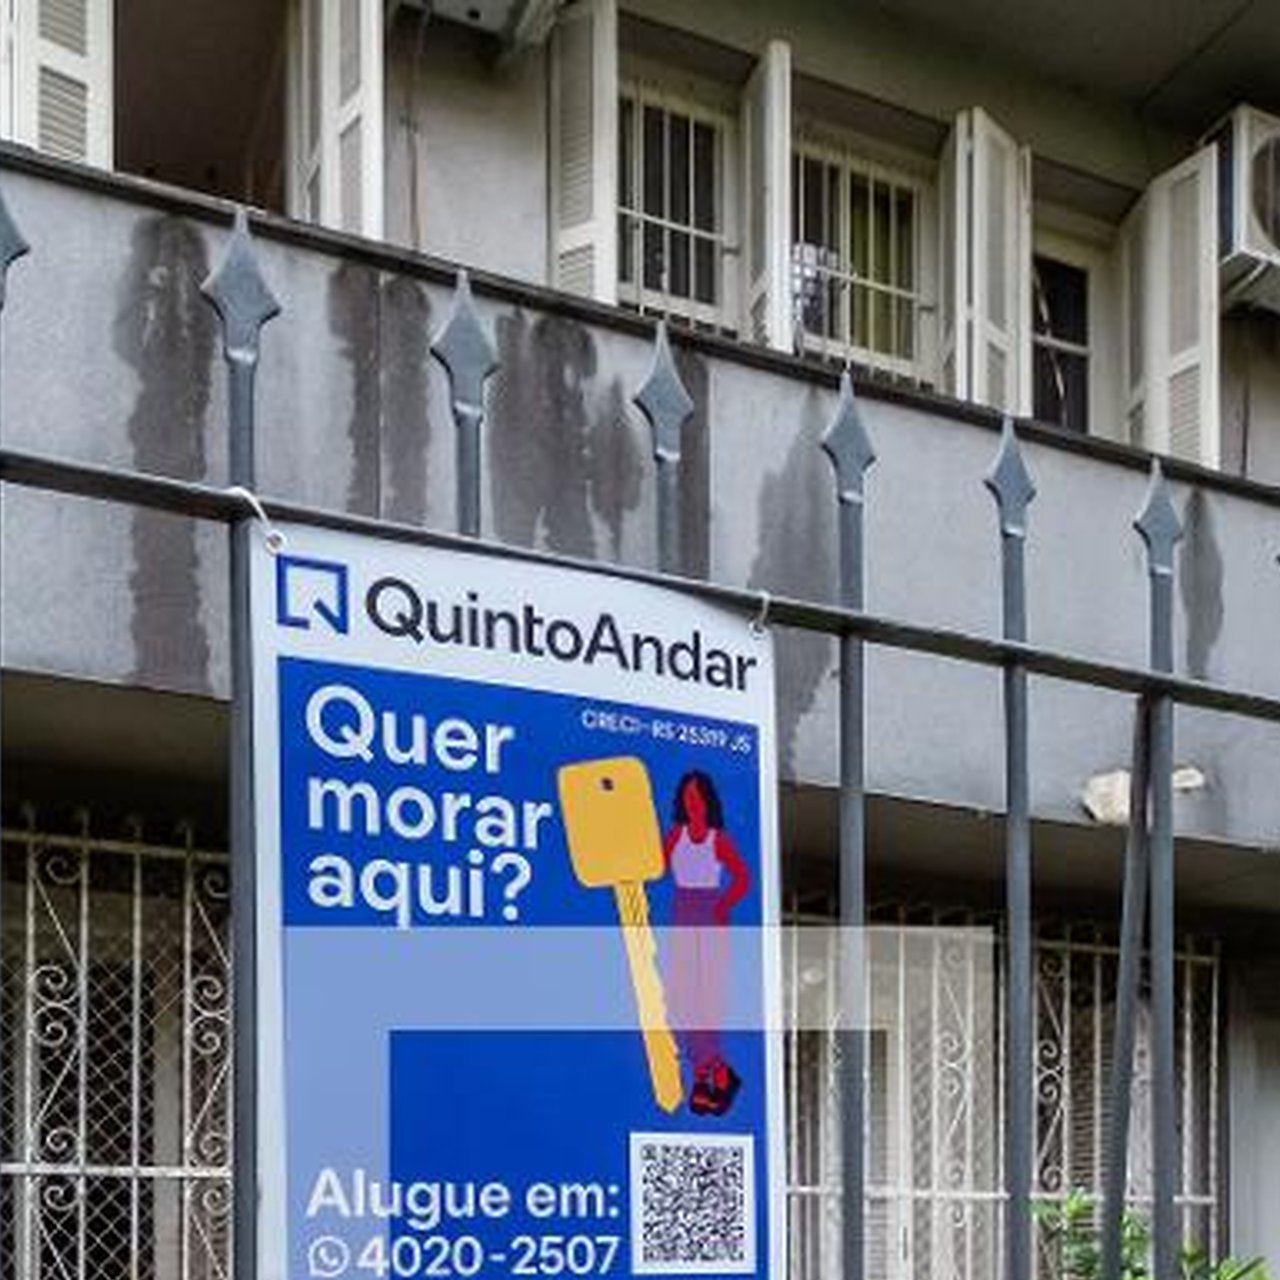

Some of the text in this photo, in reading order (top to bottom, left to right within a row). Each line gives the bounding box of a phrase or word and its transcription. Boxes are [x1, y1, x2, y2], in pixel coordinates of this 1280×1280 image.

[365, 577, 757, 691] QuintoAndar
[306, 684, 515, 773] Quer
[308, 776, 552, 849] morar
[308, 848, 532, 930] aqui?
[306, 1168, 620, 1230] Alugue em:
[357, 1235, 620, 1277] 4020-2507
